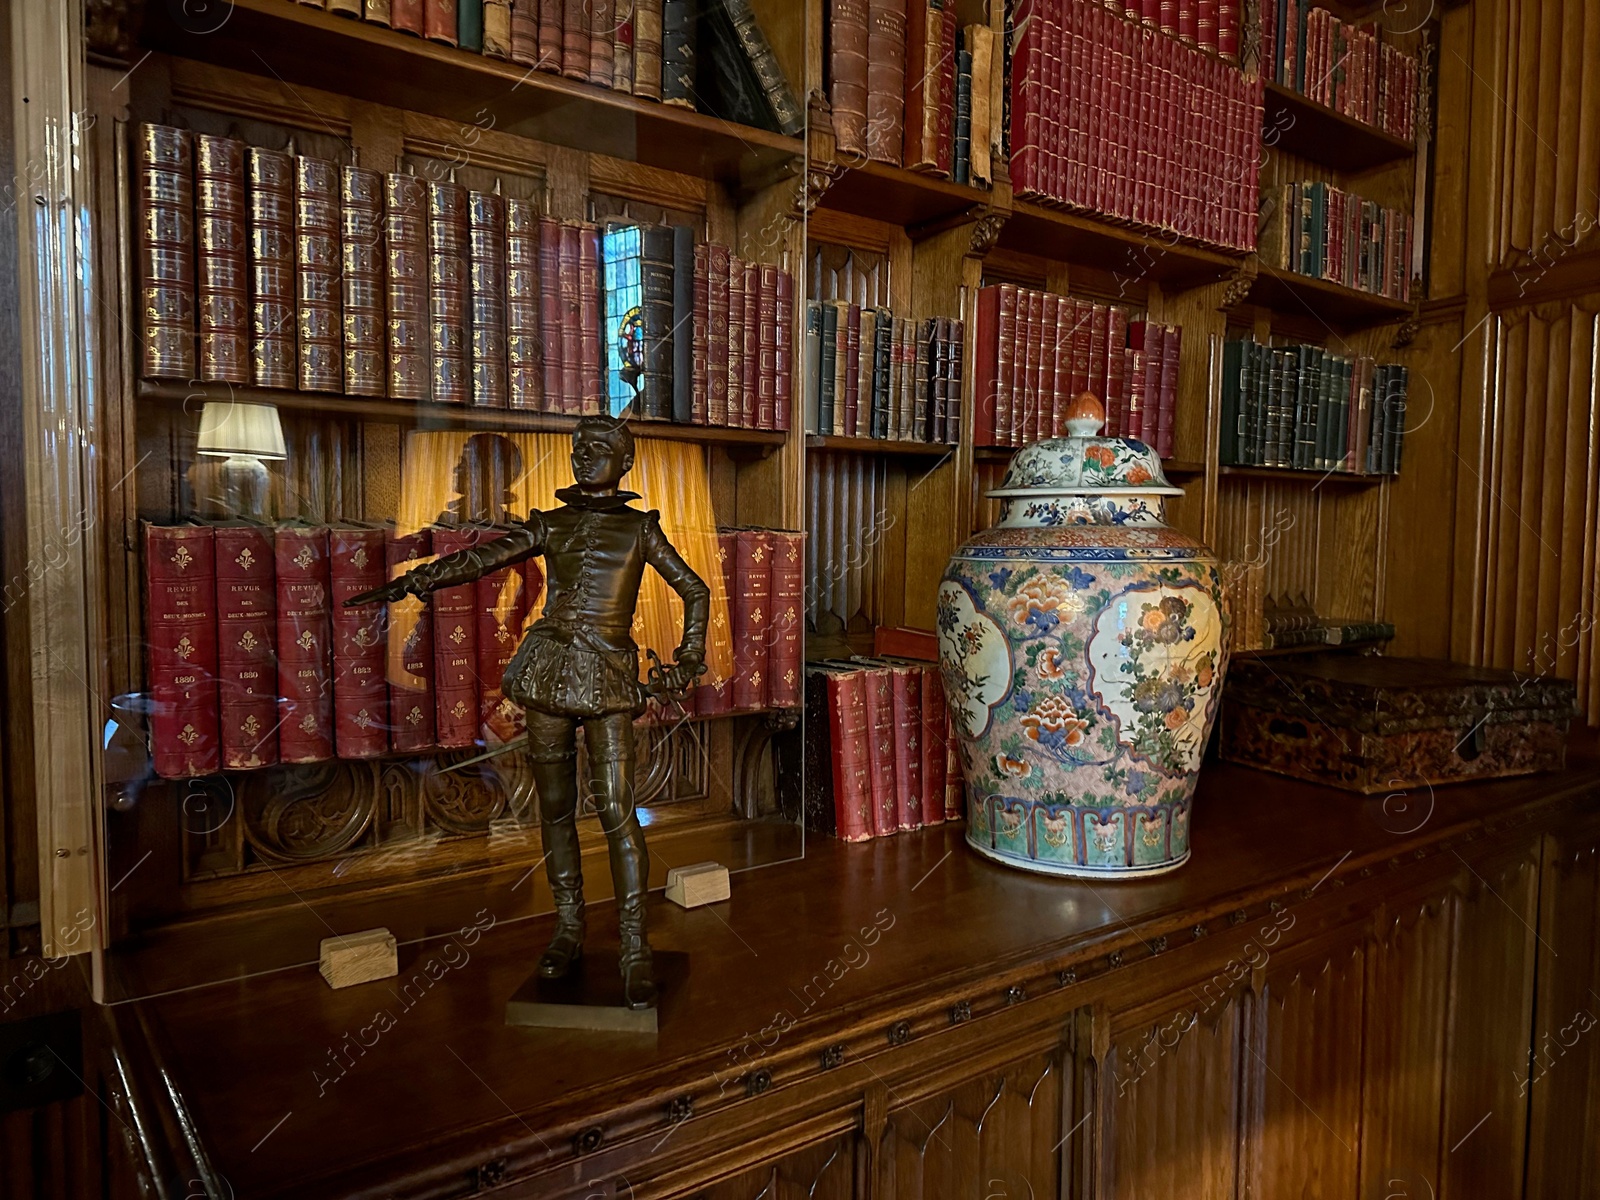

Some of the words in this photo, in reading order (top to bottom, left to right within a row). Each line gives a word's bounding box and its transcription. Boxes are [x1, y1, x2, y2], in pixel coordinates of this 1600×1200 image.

[406, 662, 424, 671] 1883
[239, 671, 258, 679] 1880
[353, 667, 372, 675] 1882
[174, 676, 195, 684] 1880
[360, 679, 366, 687] 2
[246, 687, 253, 695] 6
